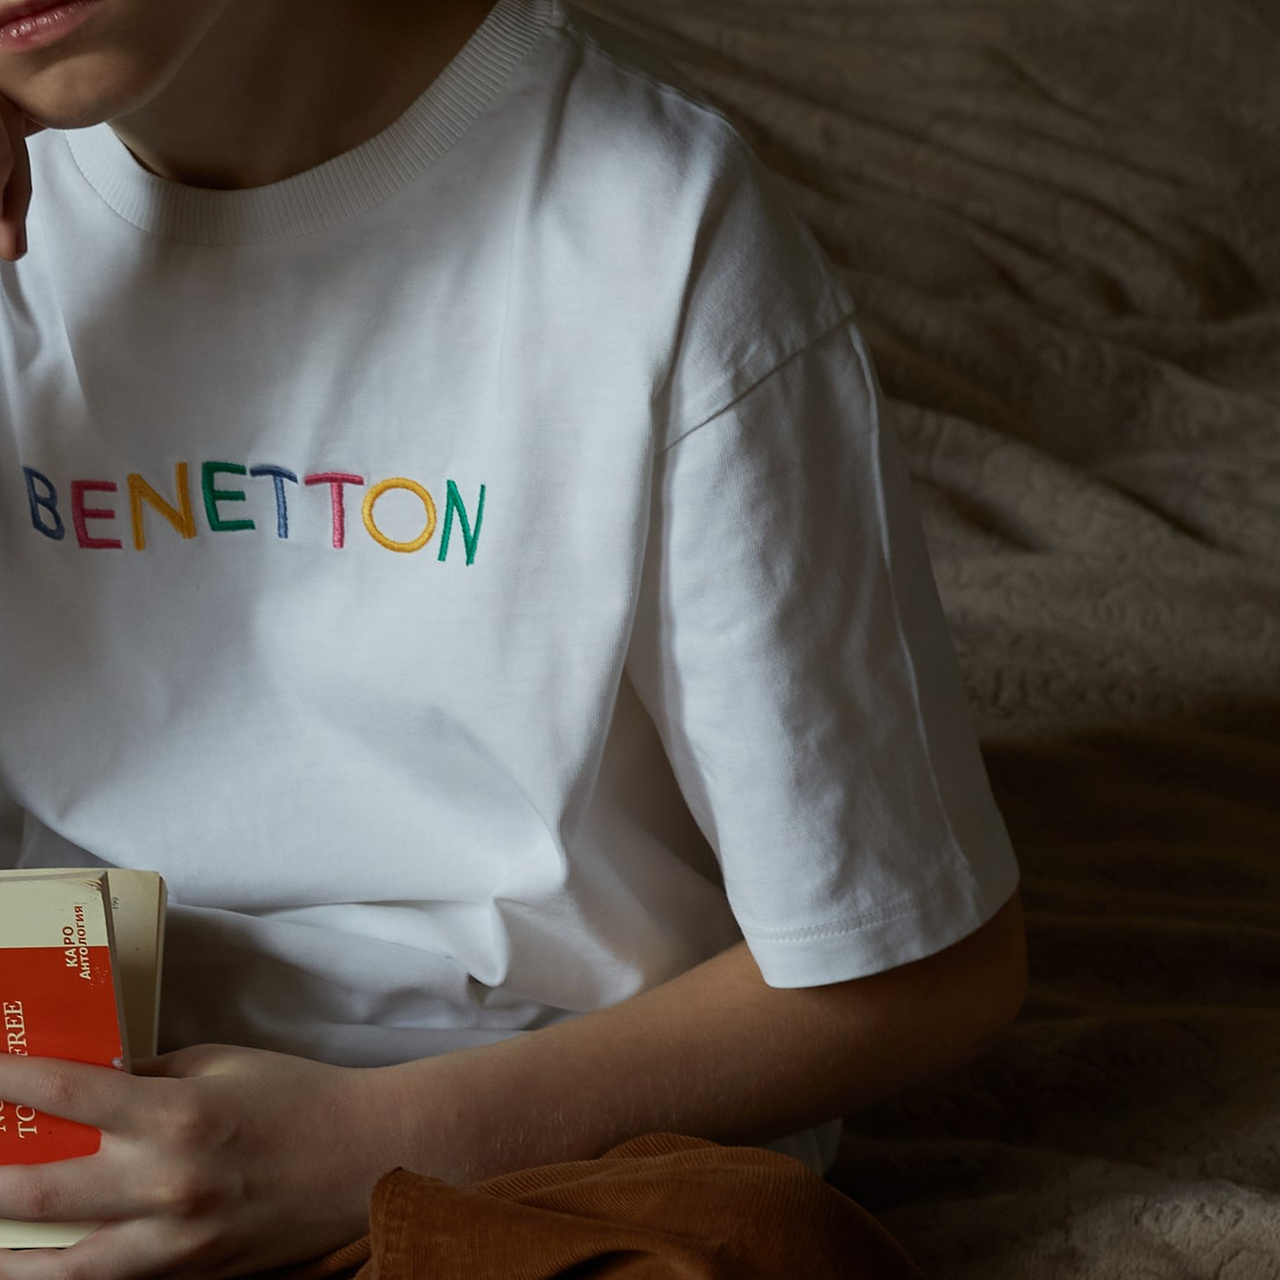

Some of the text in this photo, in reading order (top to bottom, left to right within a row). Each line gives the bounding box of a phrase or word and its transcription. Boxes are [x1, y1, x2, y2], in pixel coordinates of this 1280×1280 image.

[22, 461, 486, 567] BENETTON
[62, 926, 78, 967] КАРО
[74, 905, 91, 980] Антология
[3, 1000, 29, 1057] FREE
